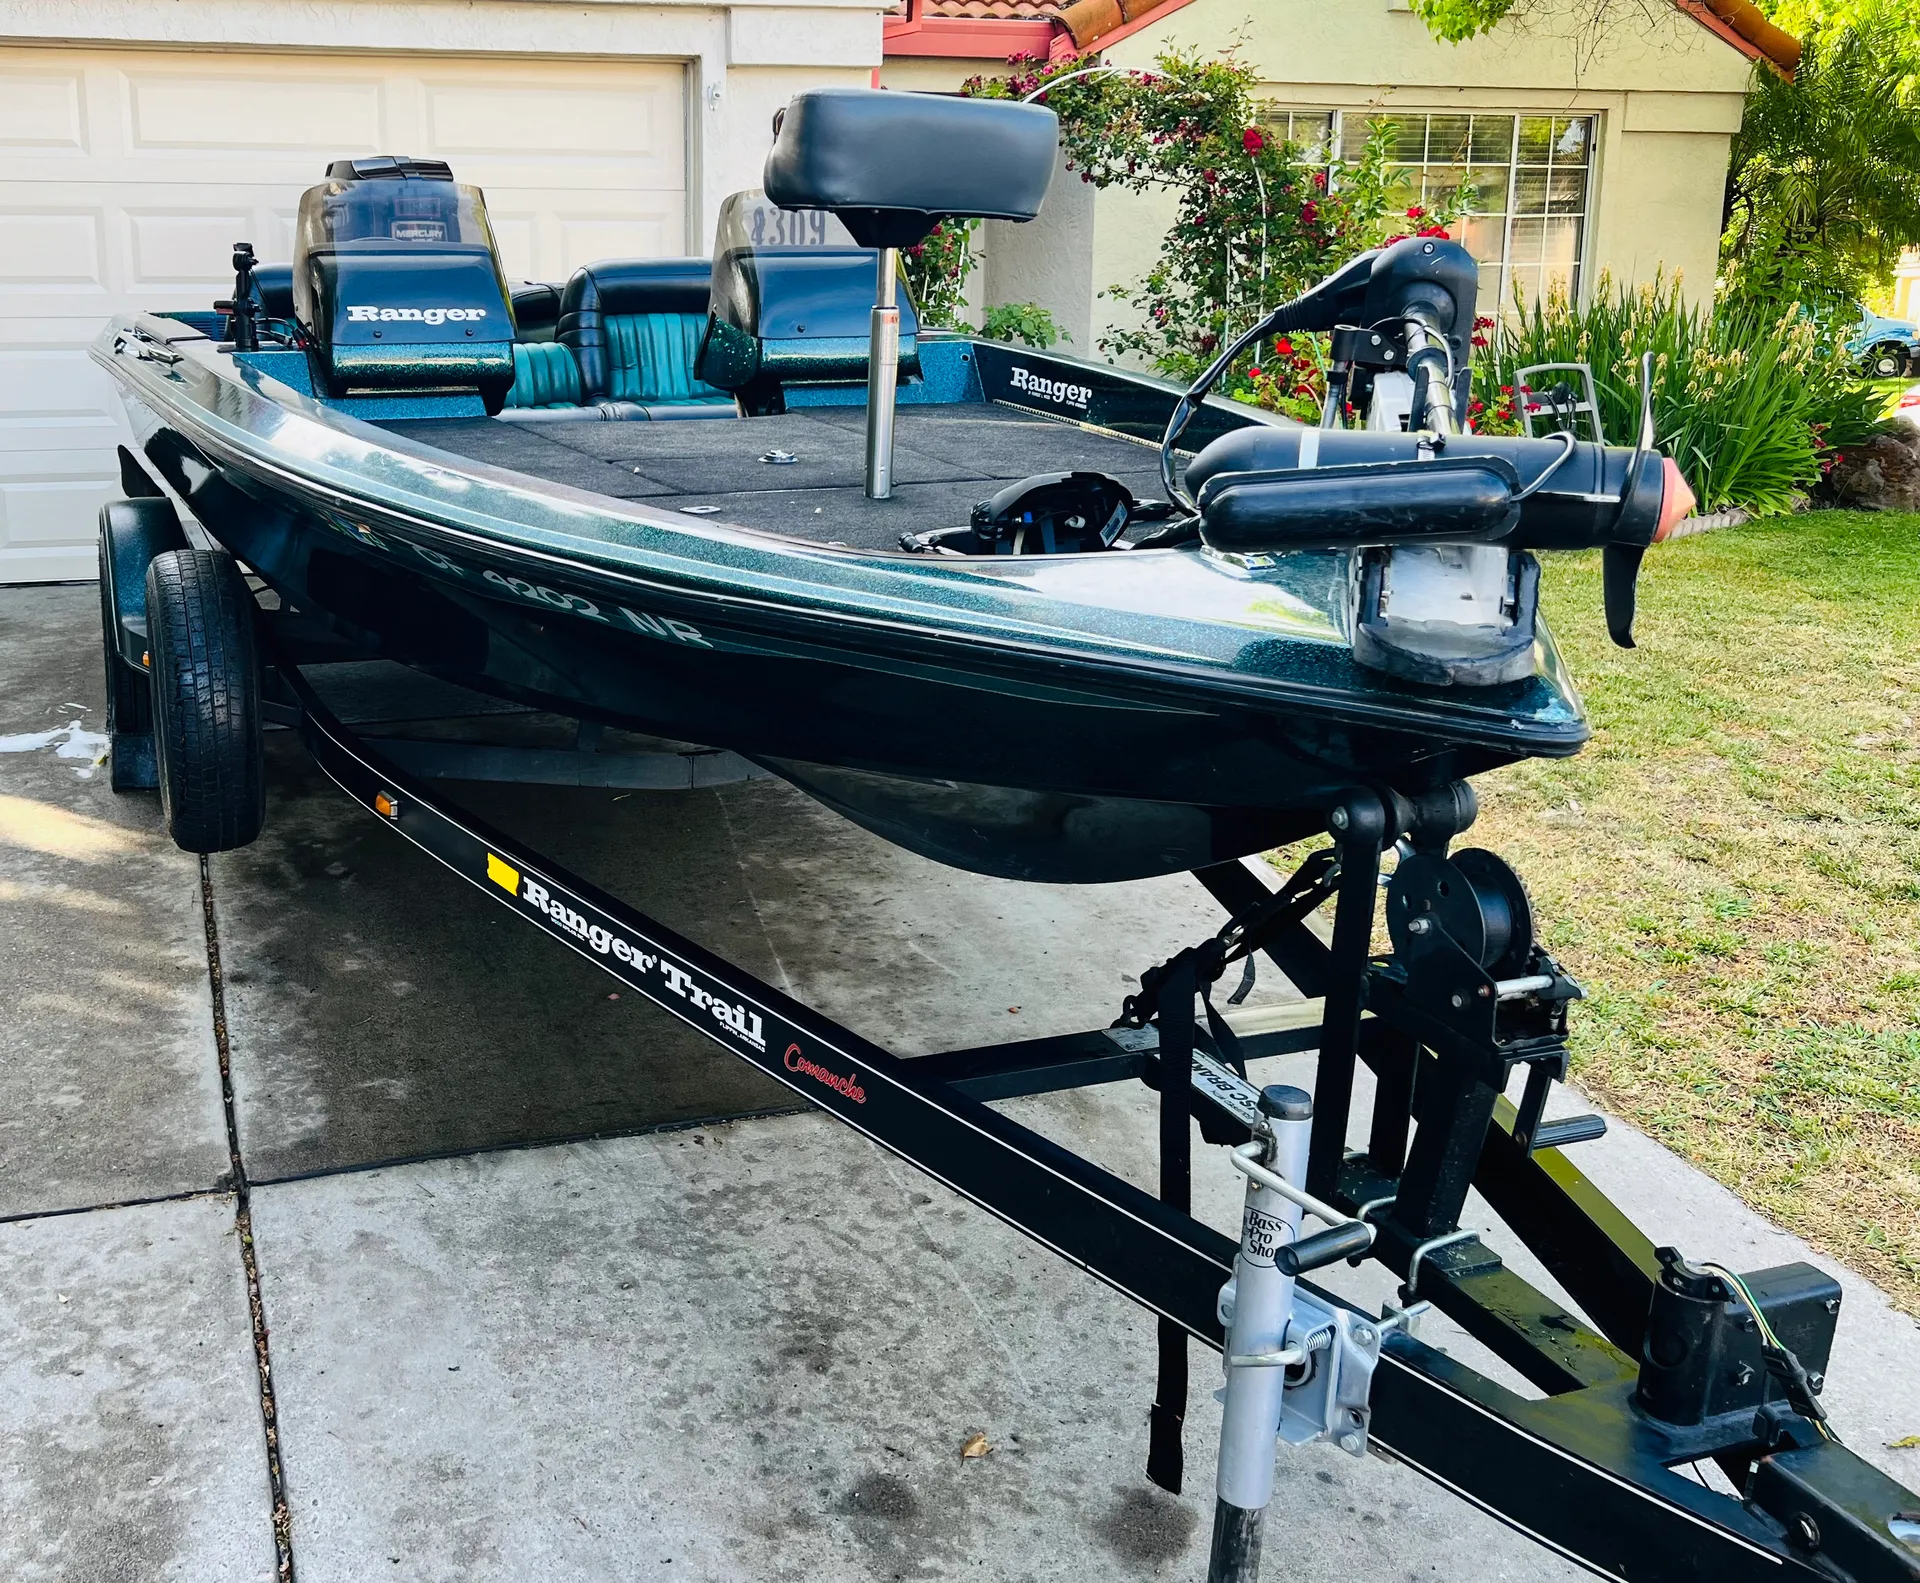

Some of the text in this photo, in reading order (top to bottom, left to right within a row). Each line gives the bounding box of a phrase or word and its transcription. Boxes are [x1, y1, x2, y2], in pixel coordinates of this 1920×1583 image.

[396, 229, 443, 238] MERCURY
[751, 206, 826, 245] 4309
[346, 305, 487, 326] Ranger
[1010, 366, 1093, 403] Ranger
[482, 570, 611, 622] 4202
[618, 606, 715, 648] NR
[522, 875, 767, 1047] Ranger Trail
[783, 1042, 867, 1105] Comanche
[1247, 1226, 1273, 1245] Pro
[1248, 1210, 1283, 1232] Bass
[1247, 1239, 1276, 1261] Sho
